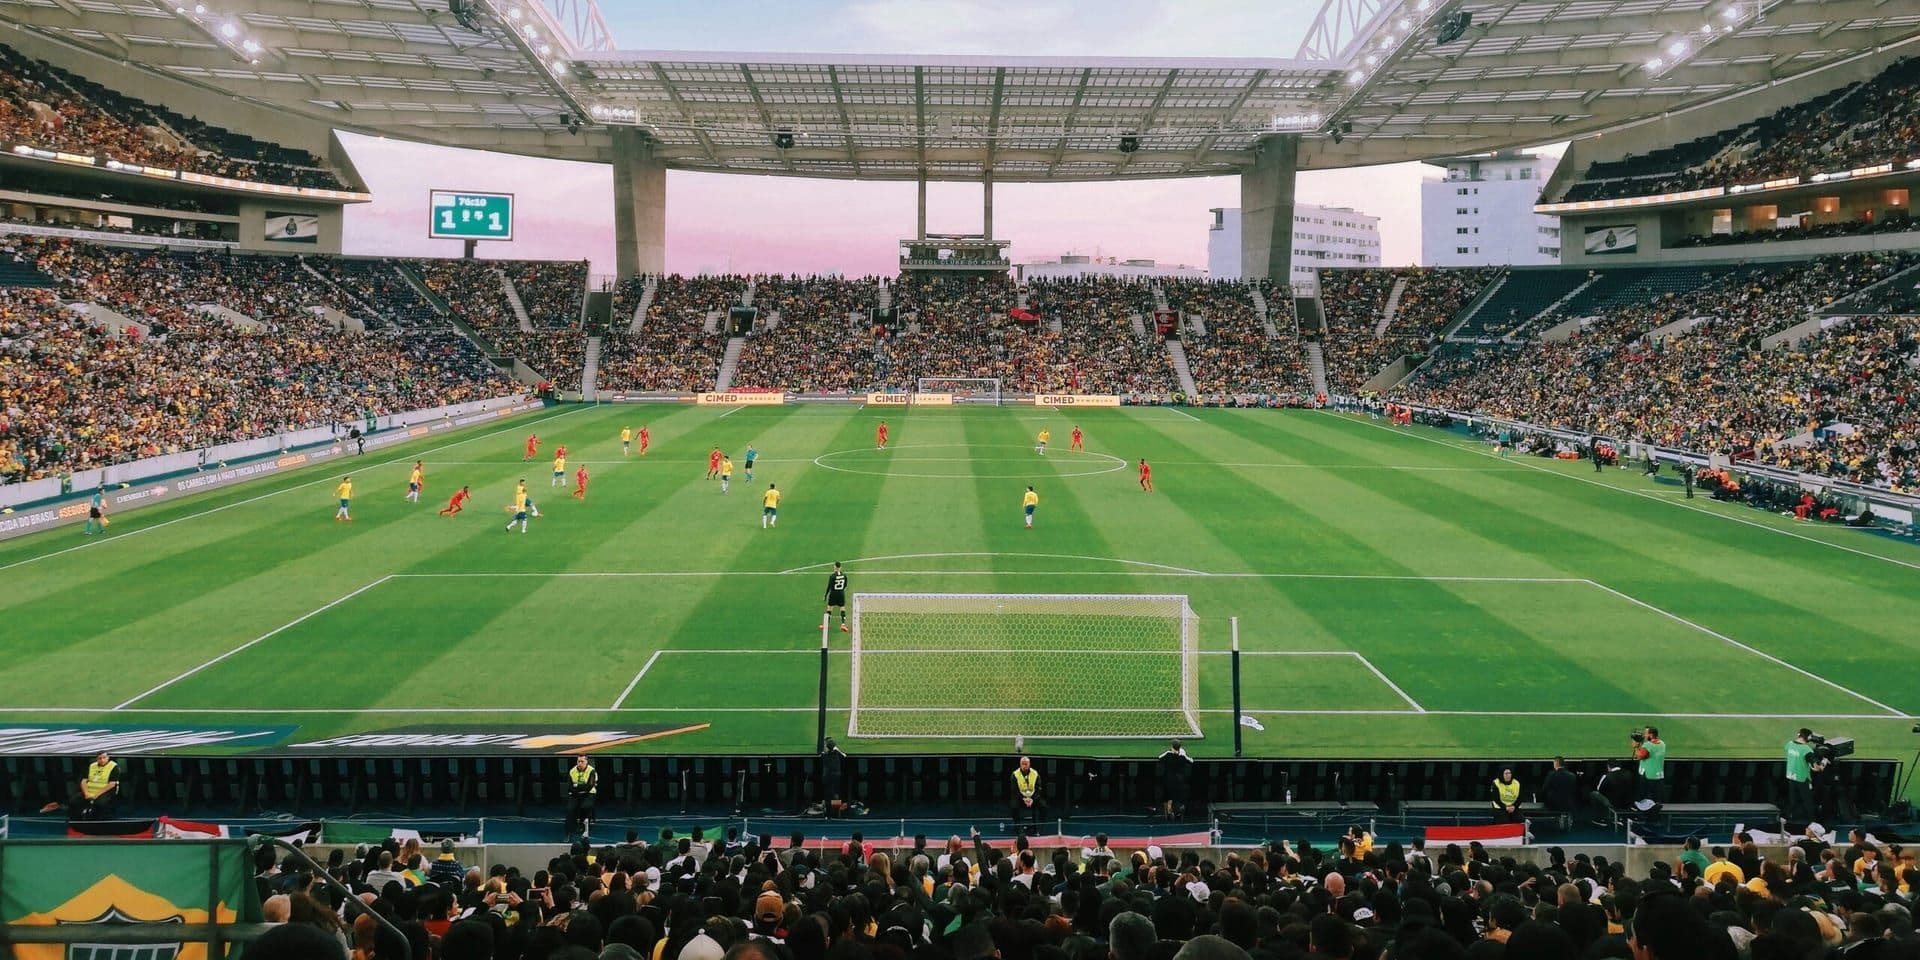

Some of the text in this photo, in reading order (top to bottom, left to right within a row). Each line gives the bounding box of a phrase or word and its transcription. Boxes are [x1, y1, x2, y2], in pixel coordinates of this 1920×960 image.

[441, 210, 503, 231] 1 1
[705, 394, 738, 402] CIMED
[875, 395, 907, 403] CIMED
[1042, 396, 1075, 404] CIMED
[834, 579, 845, 590] 23
